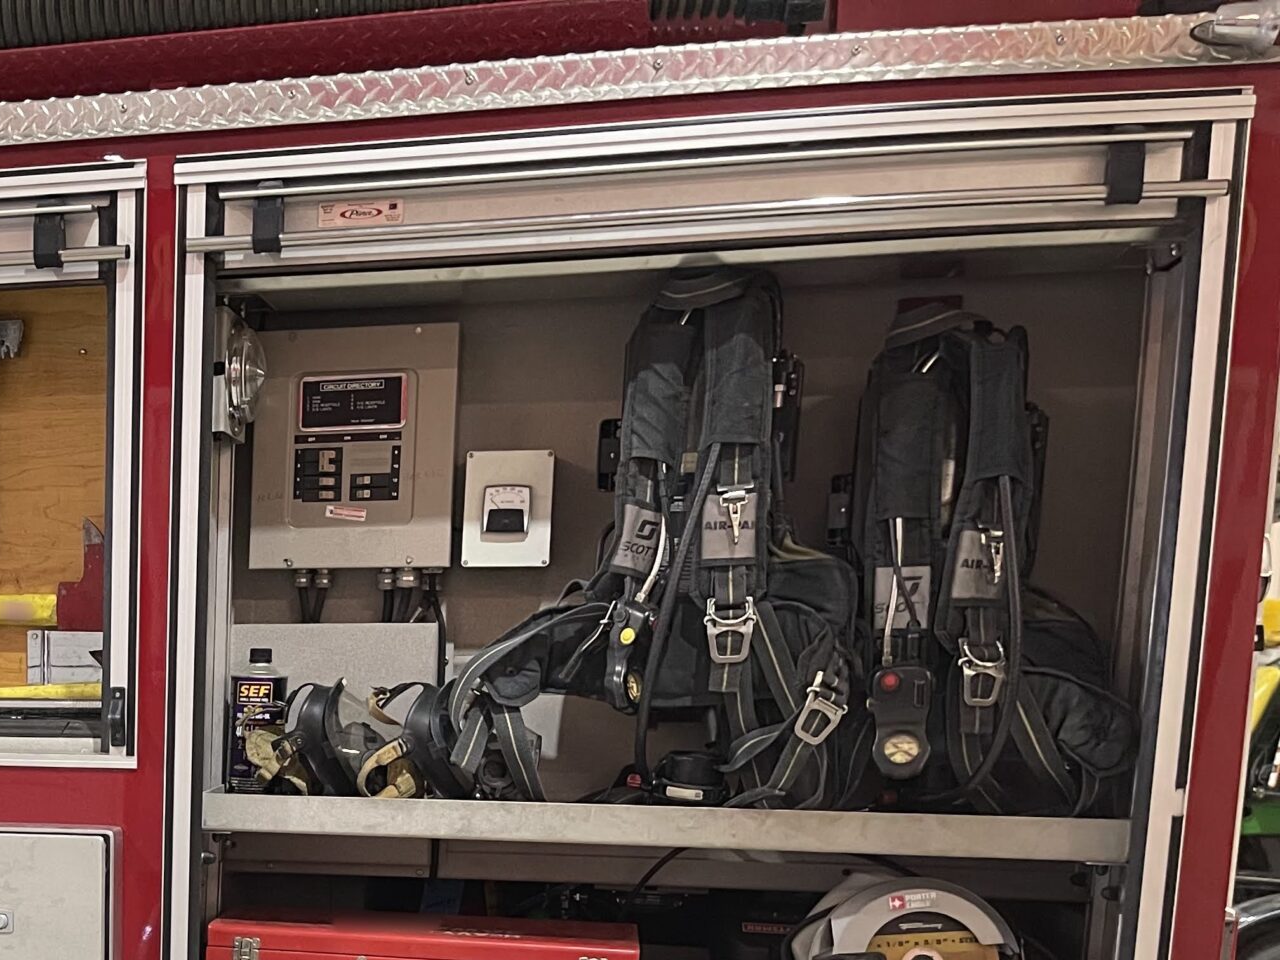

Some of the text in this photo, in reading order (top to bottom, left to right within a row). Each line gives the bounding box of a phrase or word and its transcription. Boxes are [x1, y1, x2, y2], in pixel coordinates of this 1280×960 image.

[347, 382, 381, 390] DIRECTORY
[621, 541, 654, 557] SCOT
[239, 685, 270, 697] SEF
